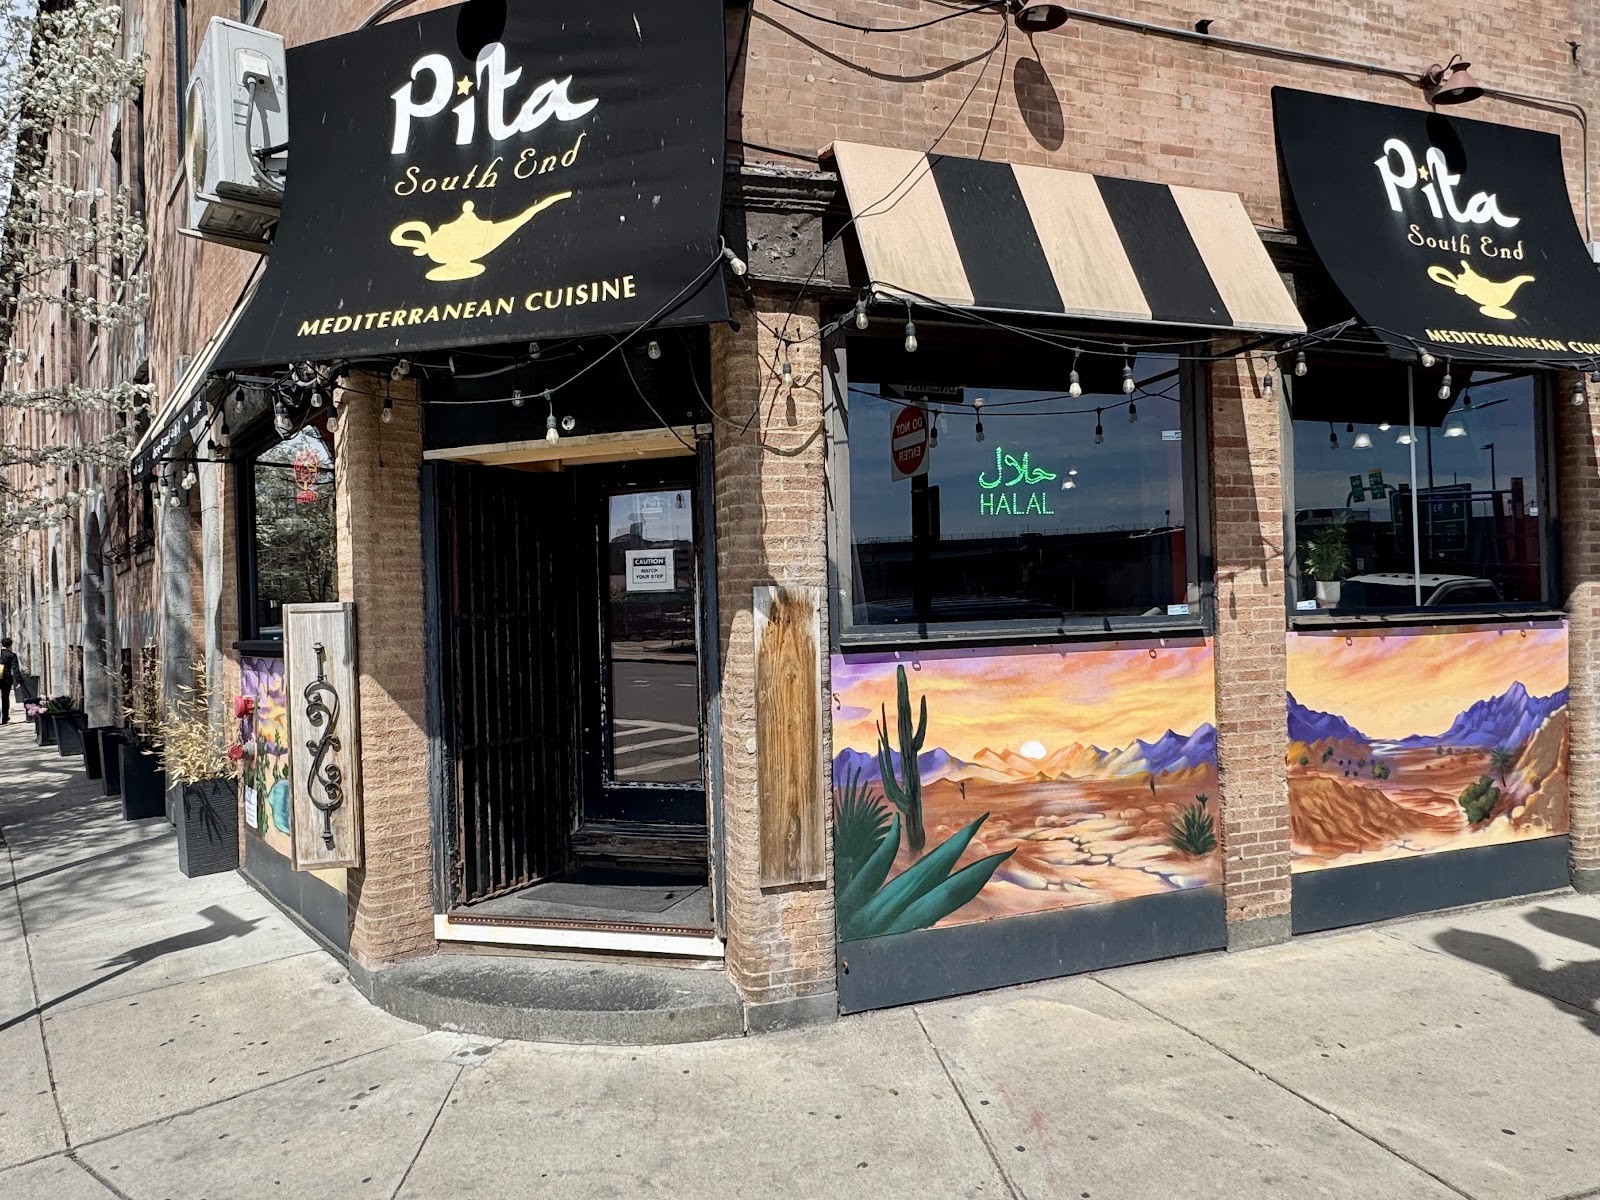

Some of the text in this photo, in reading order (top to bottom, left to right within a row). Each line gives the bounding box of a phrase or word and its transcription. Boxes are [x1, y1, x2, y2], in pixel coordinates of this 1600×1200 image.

[391, 42, 599, 154] Pita
[394, 132, 586, 196] South End
[1374, 138, 1520, 228] Pita
[1408, 225, 1524, 260] South End
[297, 275, 636, 336] MEDITERRANEAN CUISINE
[1425, 328, 1568, 352] MEDITERRANEAN
[978, 446, 1057, 489] حلال
[980, 492, 1055, 516] HALAL
